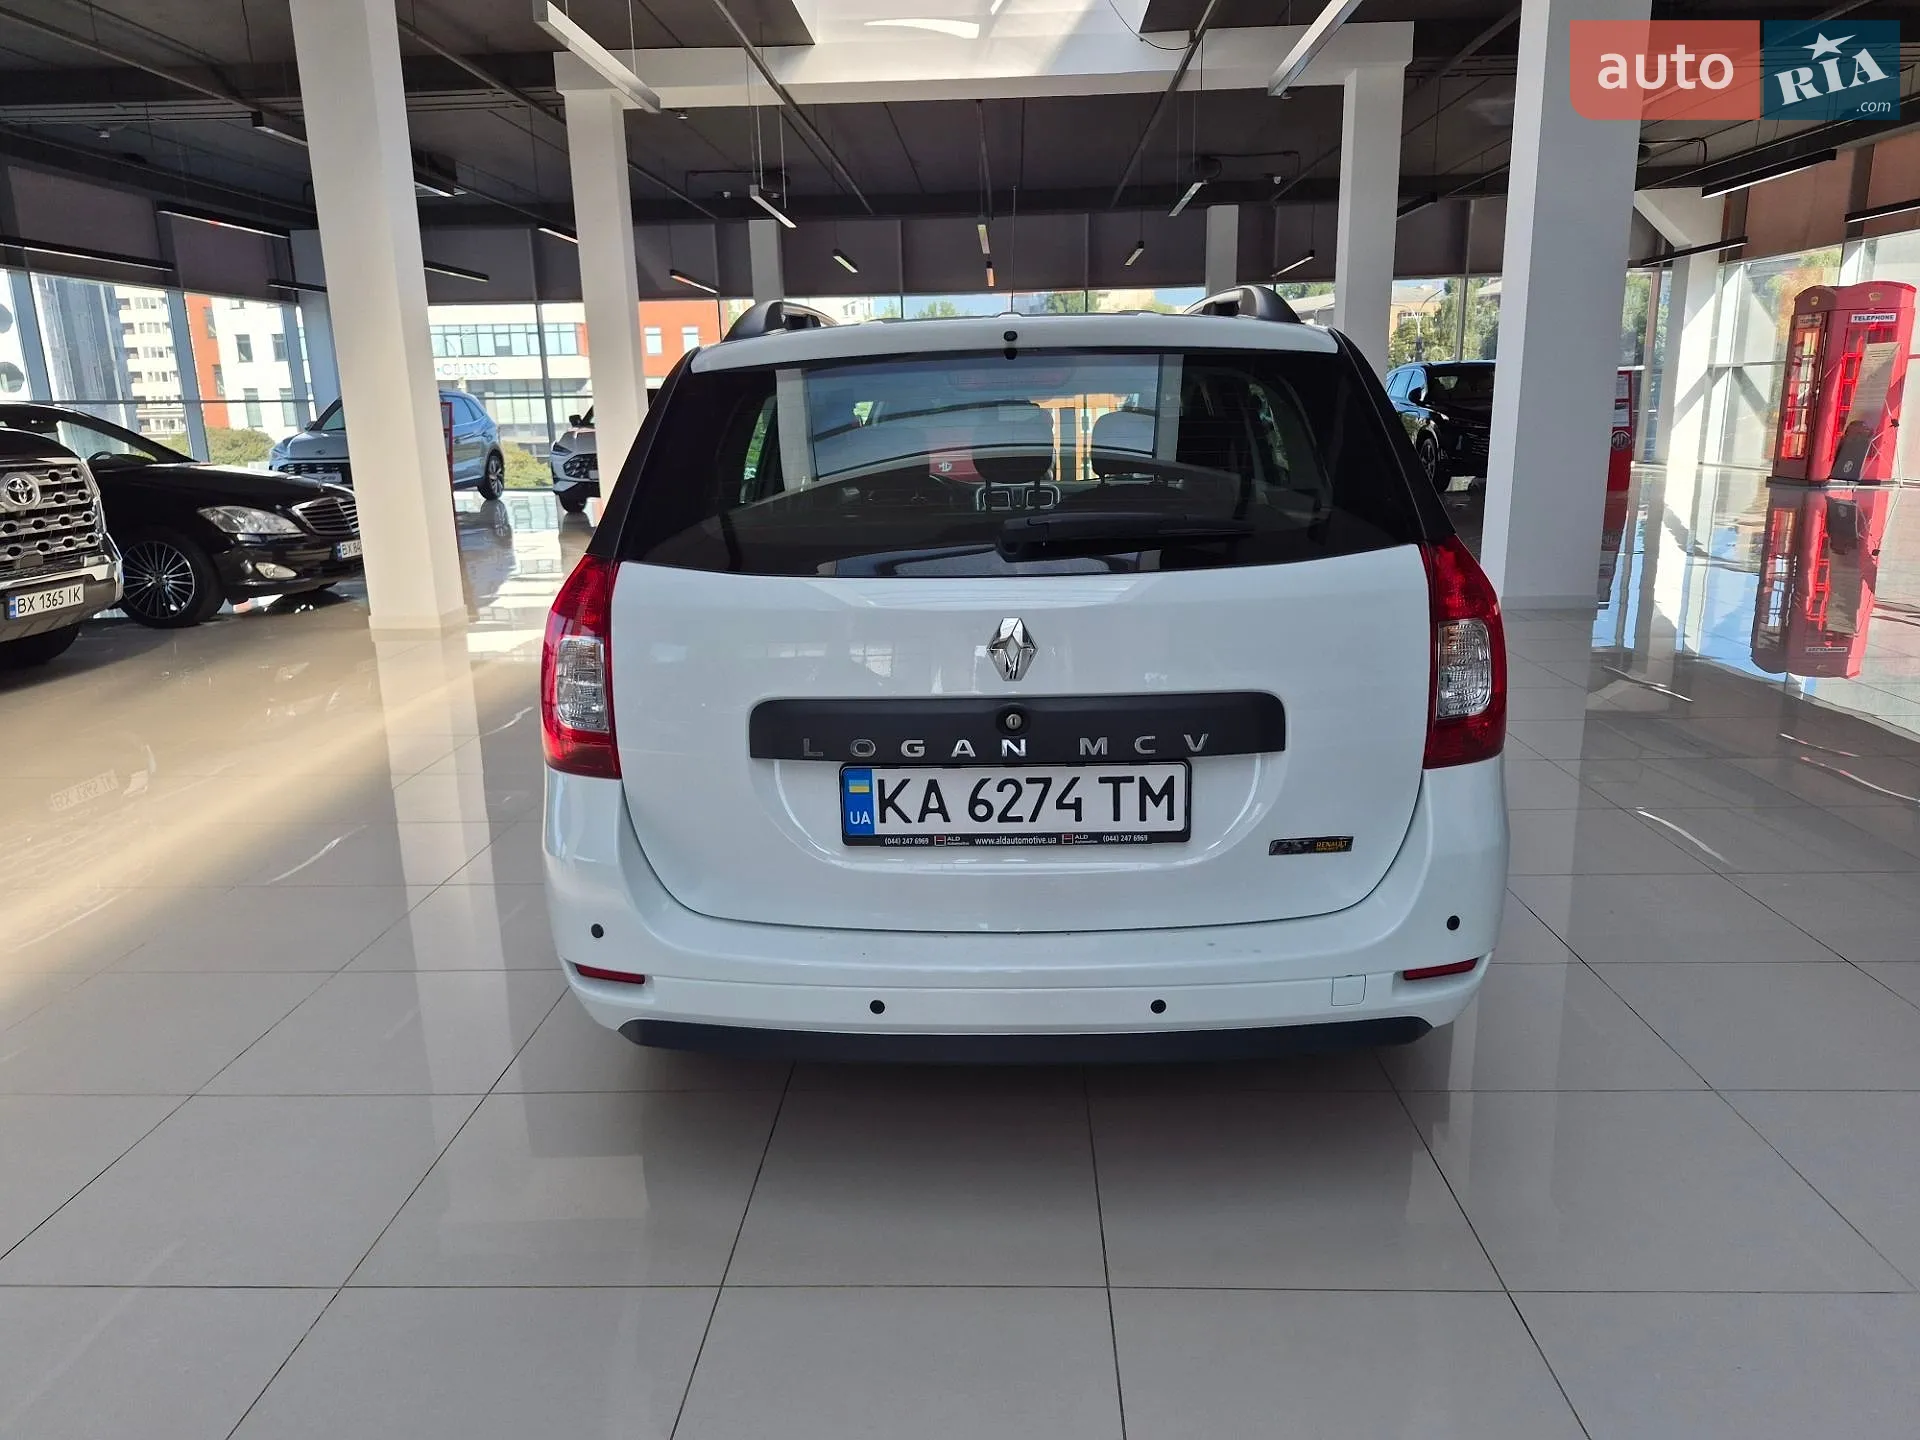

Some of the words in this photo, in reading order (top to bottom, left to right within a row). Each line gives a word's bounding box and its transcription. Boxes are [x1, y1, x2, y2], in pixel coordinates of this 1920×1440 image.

[1853, 314, 1895, 322] TELEPHONE
[442, 362, 499, 376] CLINIC
[17, 596, 35, 614] BX
[39, 590, 64, 609] 1365
[68, 586, 81, 603] IK
[802, 737, 1027, 758] LOGAN
[1079, 733, 1209, 756] MCV
[877, 778, 951, 824] KA
[967, 776, 1083, 823] 6274
[1098, 775, 1175, 822] TM
[849, 810, 871, 825] UA
[884, 837, 901, 846] (044)
[902, 837, 914, 845] 247
[974, 835, 1057, 846] www.aldautomotive.ua
[1102, 834, 1119, 843] (044)
[1120, 834, 1132, 842] 247
[1316, 840, 1348, 849] RENAULT
